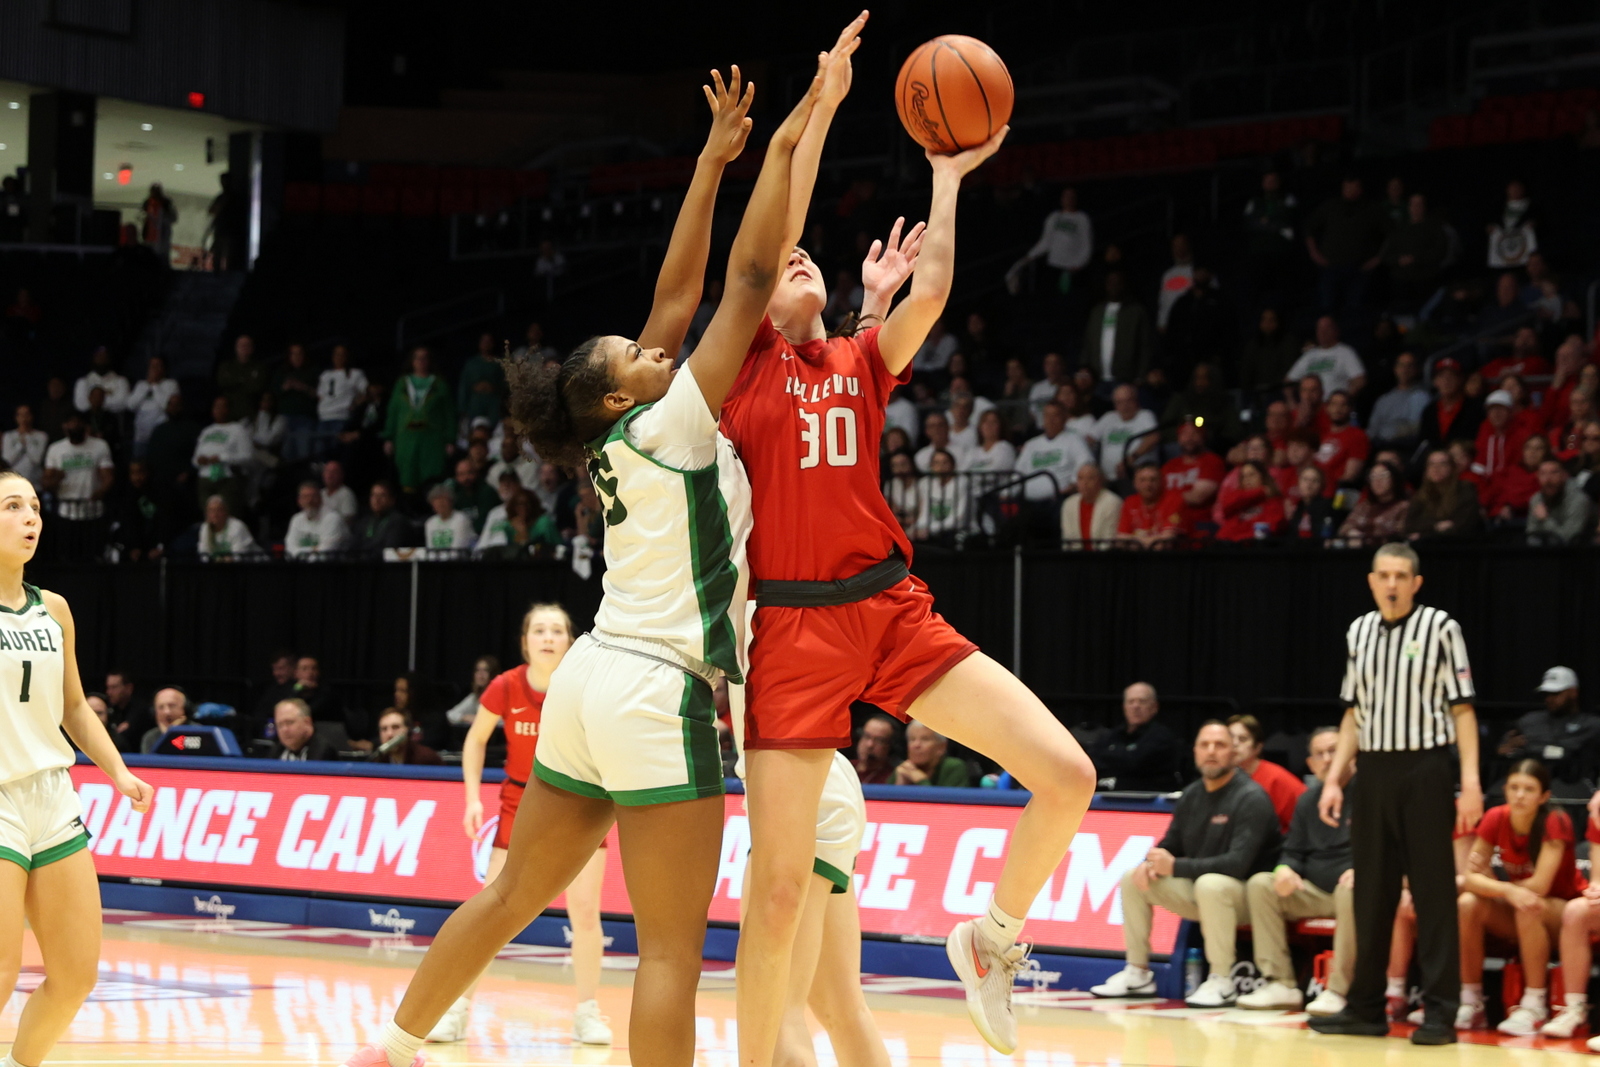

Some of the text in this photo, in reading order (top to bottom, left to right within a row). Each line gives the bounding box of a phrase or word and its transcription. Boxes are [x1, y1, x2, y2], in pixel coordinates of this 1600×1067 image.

[798, 406, 857, 469] 30
[19, 660, 32, 703] 1
[514, 720, 540, 736] BEL
[78, 782, 438, 877] DANCE CAM
[942, 827, 1155, 926] CM
